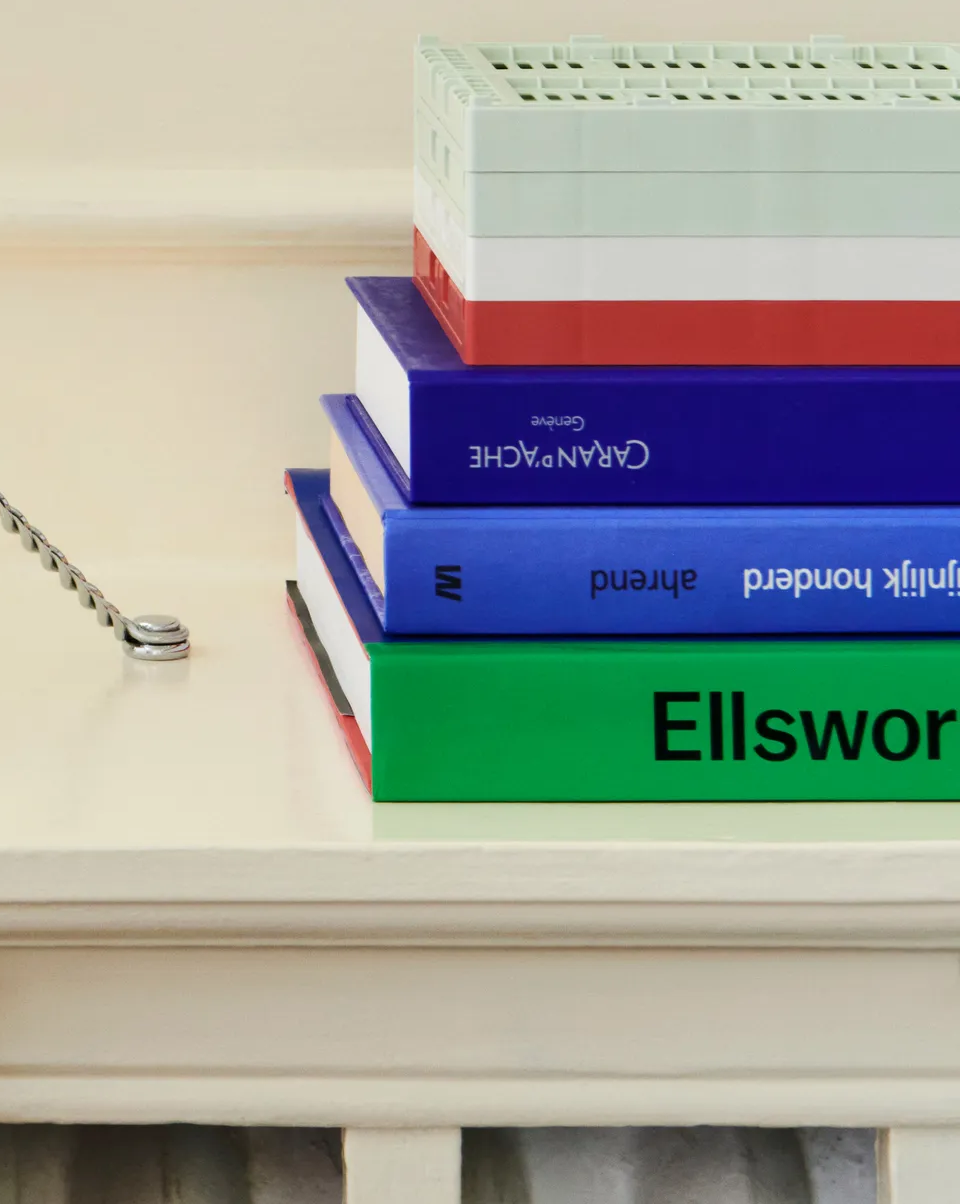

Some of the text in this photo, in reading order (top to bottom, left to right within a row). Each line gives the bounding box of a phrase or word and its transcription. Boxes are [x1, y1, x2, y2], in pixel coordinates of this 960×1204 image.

[531, 415, 585, 432] Genève
[557, 439, 650, 470] CARAN
[591, 569, 697, 600] ahrend
[743, 567, 873, 599] honderd
[653, 690, 958, 762] Ellswor
